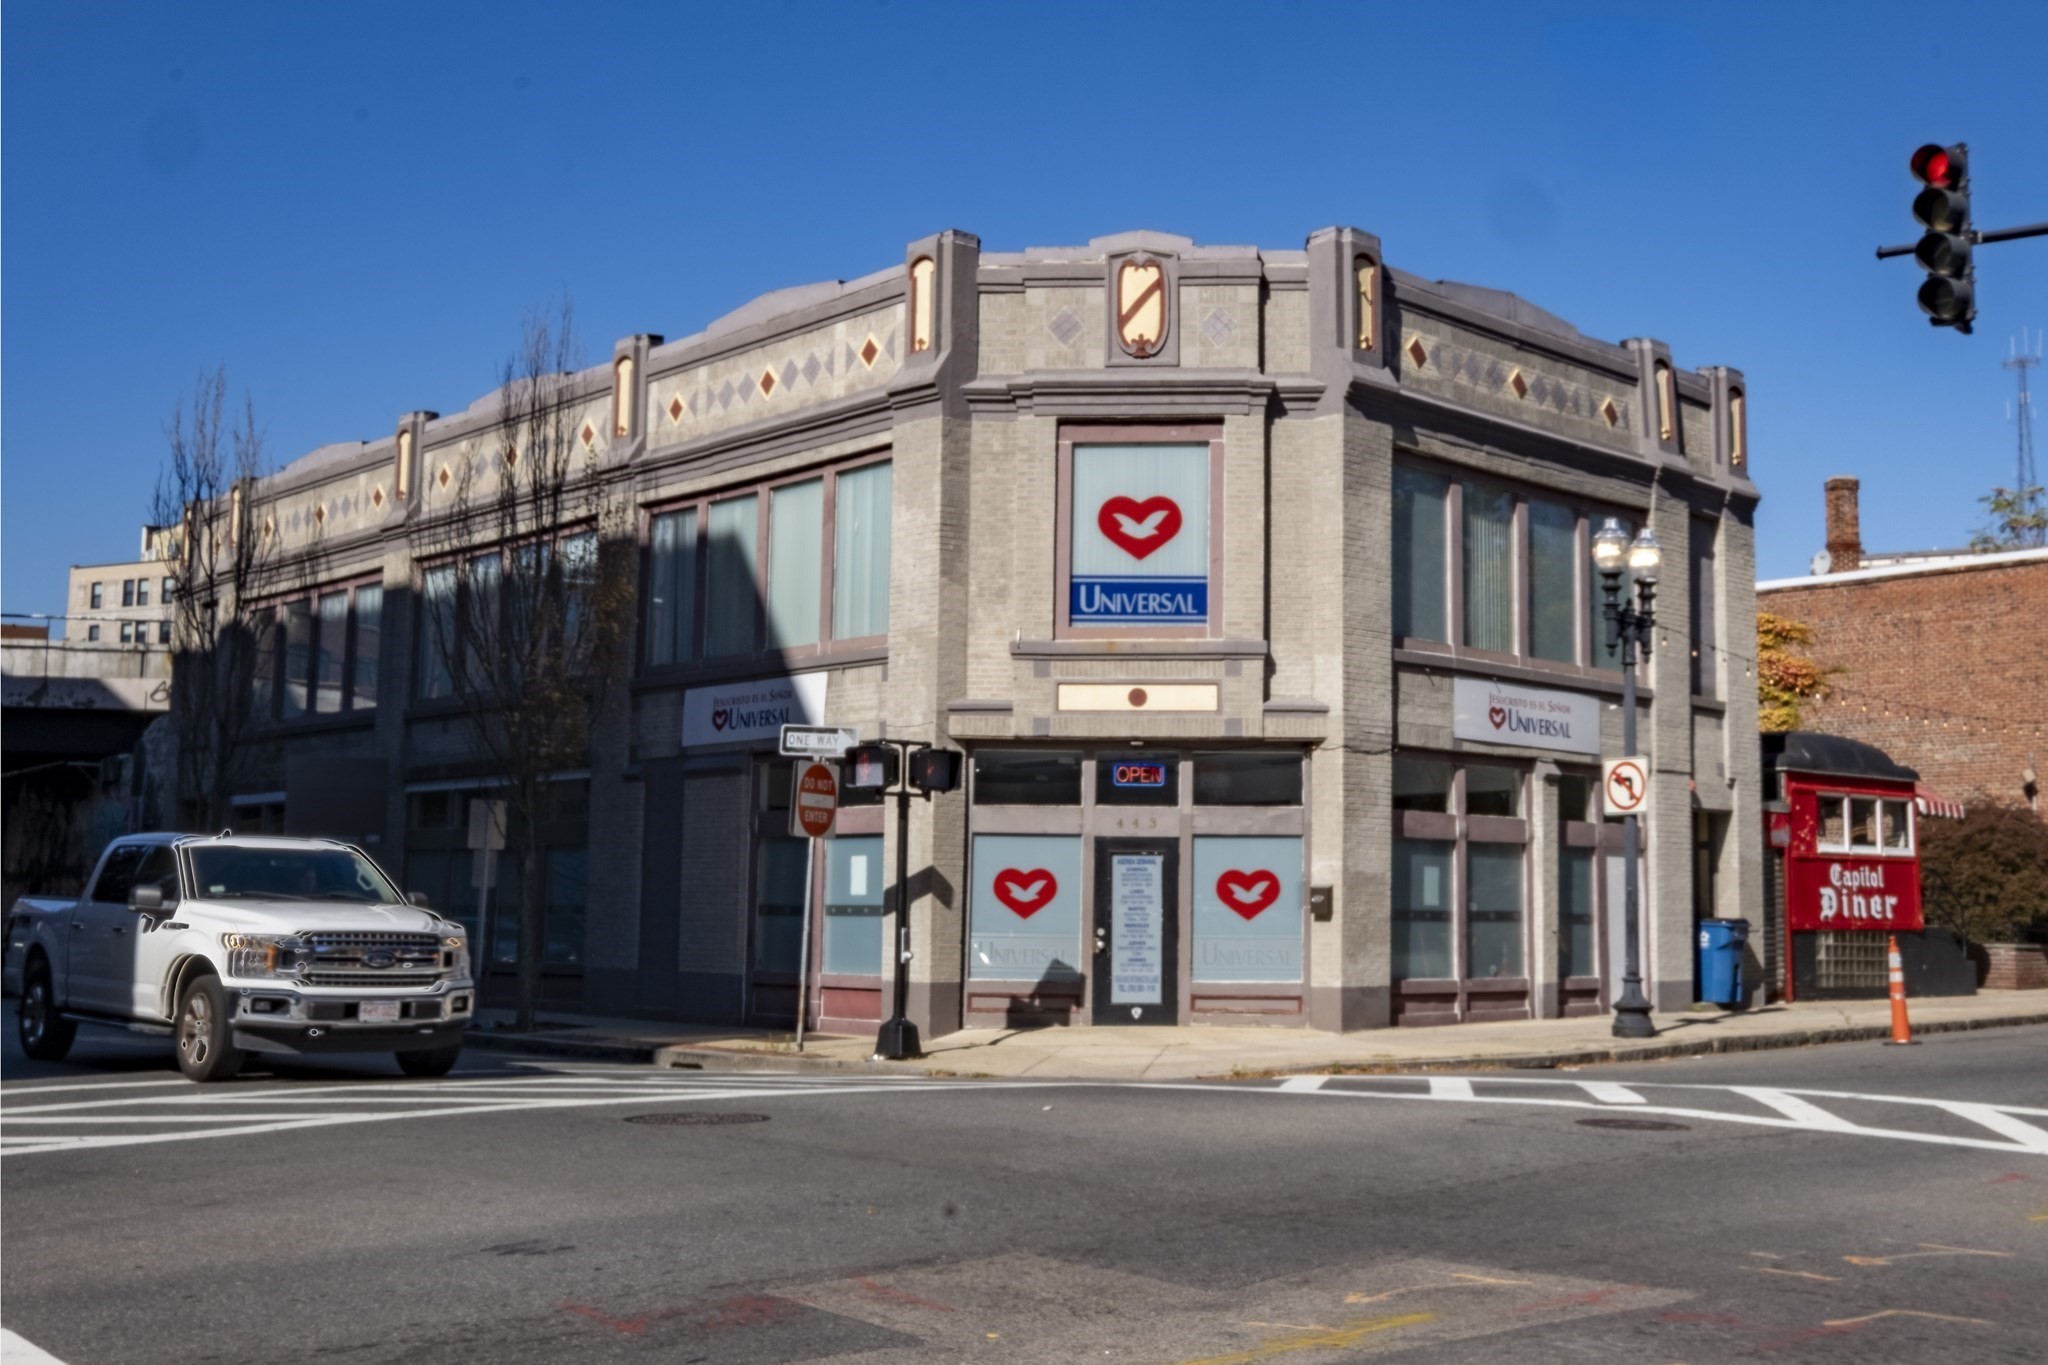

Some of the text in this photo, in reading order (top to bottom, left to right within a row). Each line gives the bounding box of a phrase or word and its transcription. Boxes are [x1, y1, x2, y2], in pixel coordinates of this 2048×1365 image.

[1080, 584, 1198, 614] UNIVERSAL
[729, 707, 792, 730] UNIVERSAL
[1508, 708, 1572, 739] UNIVERSAL
[788, 734, 840, 746] ONE WAY
[804, 777, 832, 791] DO NOT
[1116, 766, 1162, 783] OPEN
[804, 810, 828, 823] ENTER
[1830, 862, 1885, 892] Capitol
[1819, 886, 1898, 922] Diner
[1202, 942, 1292, 966] UNIVERSAL
